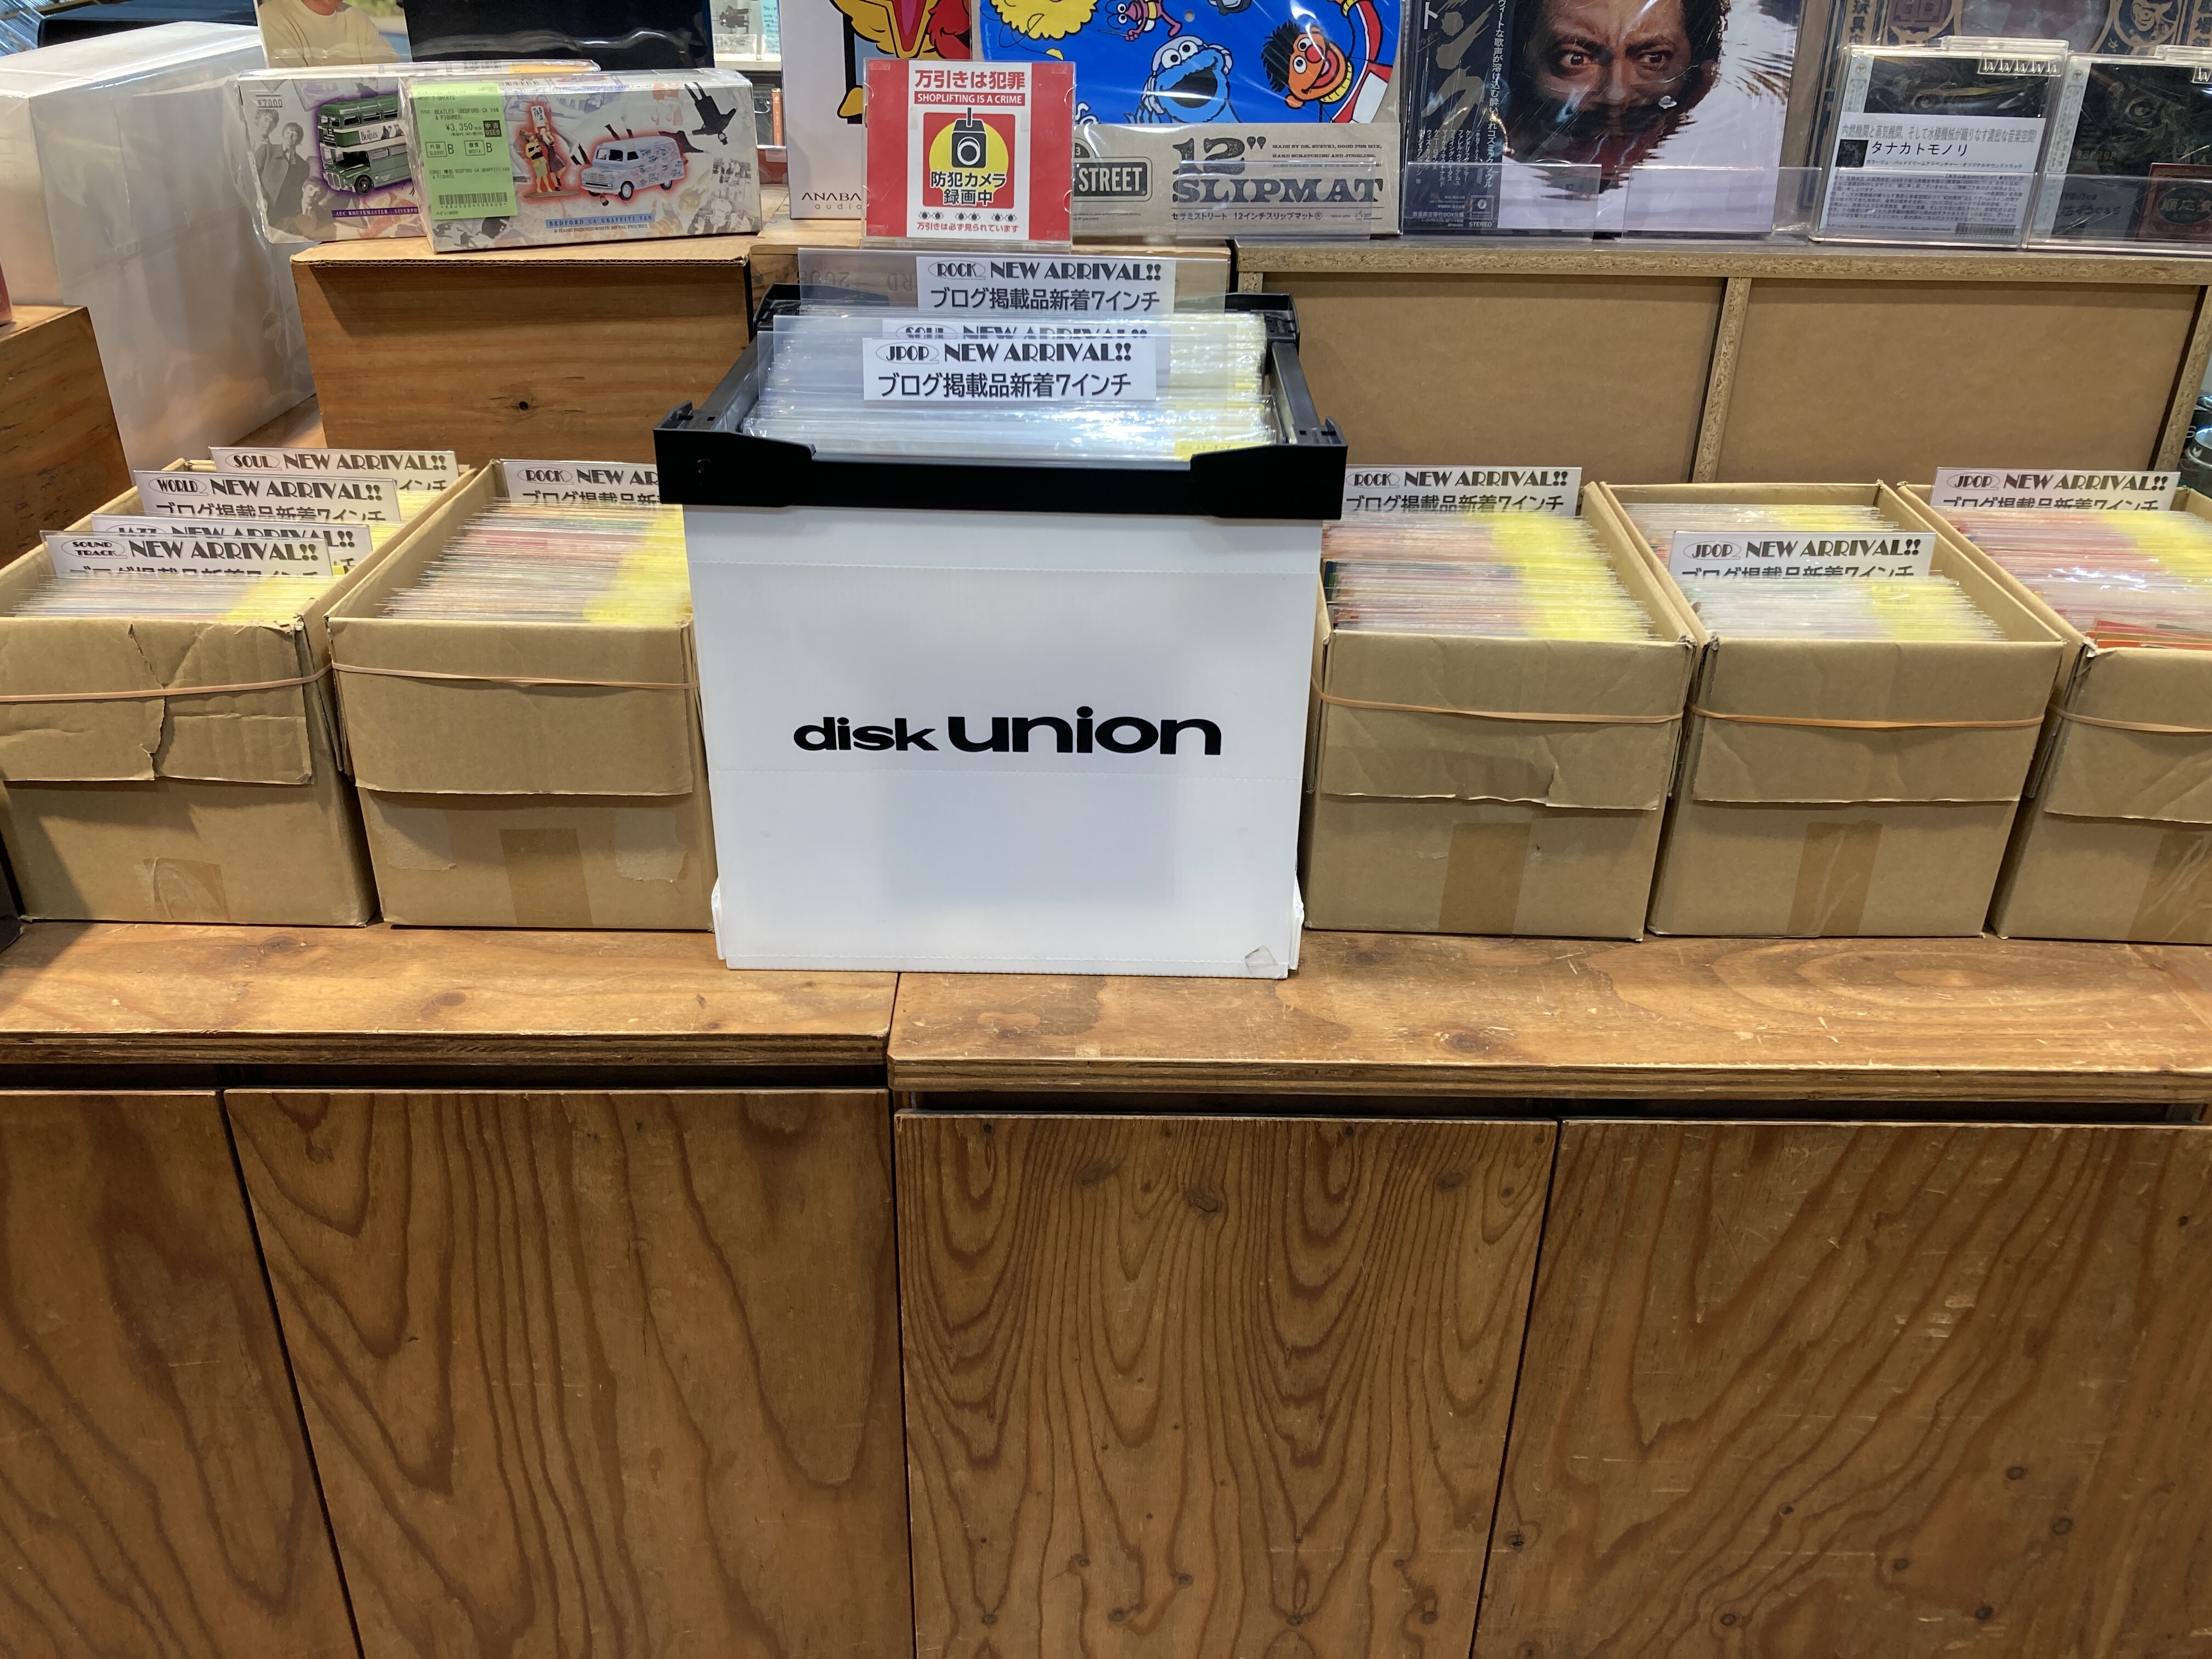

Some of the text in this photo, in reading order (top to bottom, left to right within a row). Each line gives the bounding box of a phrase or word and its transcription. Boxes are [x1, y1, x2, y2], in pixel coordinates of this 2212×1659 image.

[915, 70, 1025, 90] 万引きは犯罪
[917, 93, 1023, 104] SHOPLIFTING IS A CRIME
[1484, 0, 1506, 188] ウィートな歌声が溶け込む酔いれコズミックソウル
[445, 123, 473, 132] ¥3,350
[447, 144, 454, 154] B
[486, 143, 493, 153] B
[1871, 140, 1968, 156] タナカトモノリ
[930, 171, 1006, 188] 防犯カメラ
[1078, 167, 1143, 192] STREET
[944, 189, 993, 205] 録画中
[1172, 179, 1384, 203] SLIPMAT
[1171, 212, 1228, 221] セサミストリート
[917, 222, 1019, 233] 万引きは必ず見られています
[937, 261, 1161, 281] ROCK NEW ARRIVAL!!
[930, 287, 1160, 312] ブログ掲載品新着7インチ
[885, 342, 1132, 362] JPOP NEW ARRIVAL!!
[878, 373, 1132, 397] ブログ掲載品新着7インチ
[233, 453, 447, 471] SOUL NEW ARRIVAL!!
[526, 469, 564, 482] ROCK
[576, 469, 624, 485] NEW
[1354, 471, 1568, 487] ROCK NEW ARRIVAL!!
[1954, 474, 2169, 490] JPOP NEW ARRIVAL!!
[156, 478, 382, 501] WORLD NEW ARRIVAL!!
[128, 540, 185, 558] NEW
[190, 541, 319, 561] ARRIVAL!!
[1691, 539, 1921, 558] JPOP NEW ARRIVAL!!
[793, 706, 1222, 755] disk union
